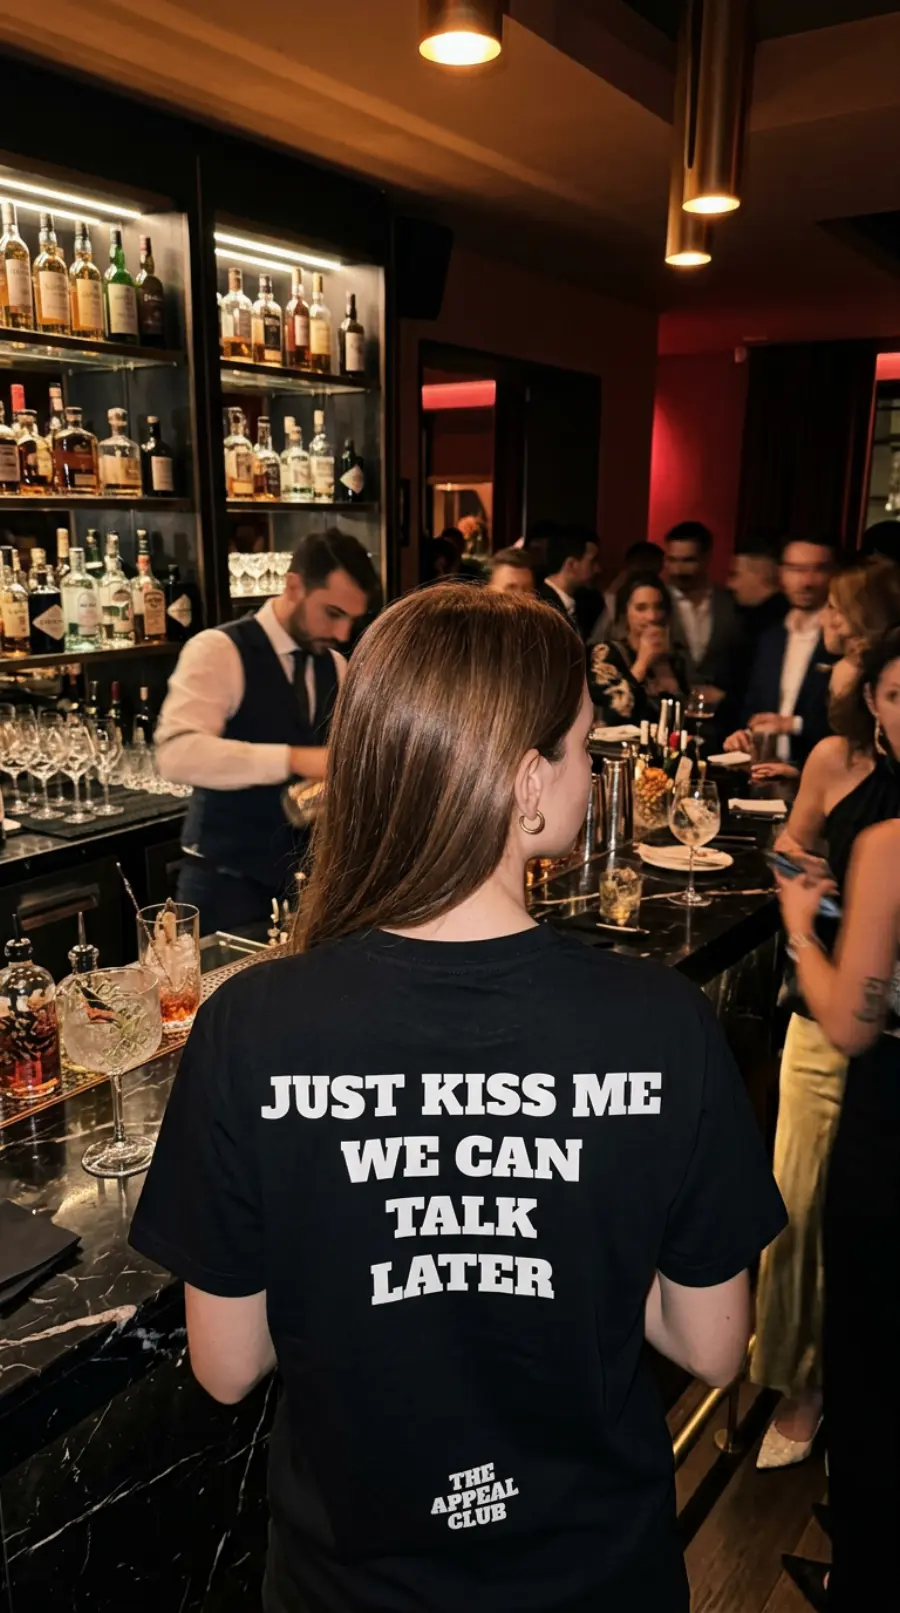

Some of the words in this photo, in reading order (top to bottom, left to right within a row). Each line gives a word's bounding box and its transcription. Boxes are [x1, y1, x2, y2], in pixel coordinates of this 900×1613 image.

[261, 1074, 405, 1120] JUST
[421, 1073, 557, 1117] KISS
[572, 1072, 662, 1117] ME
[340, 1136, 439, 1183] WE
[455, 1135, 583, 1182] CAN
[385, 1196, 537, 1239] TALK
[371, 1254, 555, 1305] LATER
[430, 1477, 519, 1515] APPEAL
[448, 1462, 496, 1491] THE
[447, 1502, 507, 1530] CLUB
